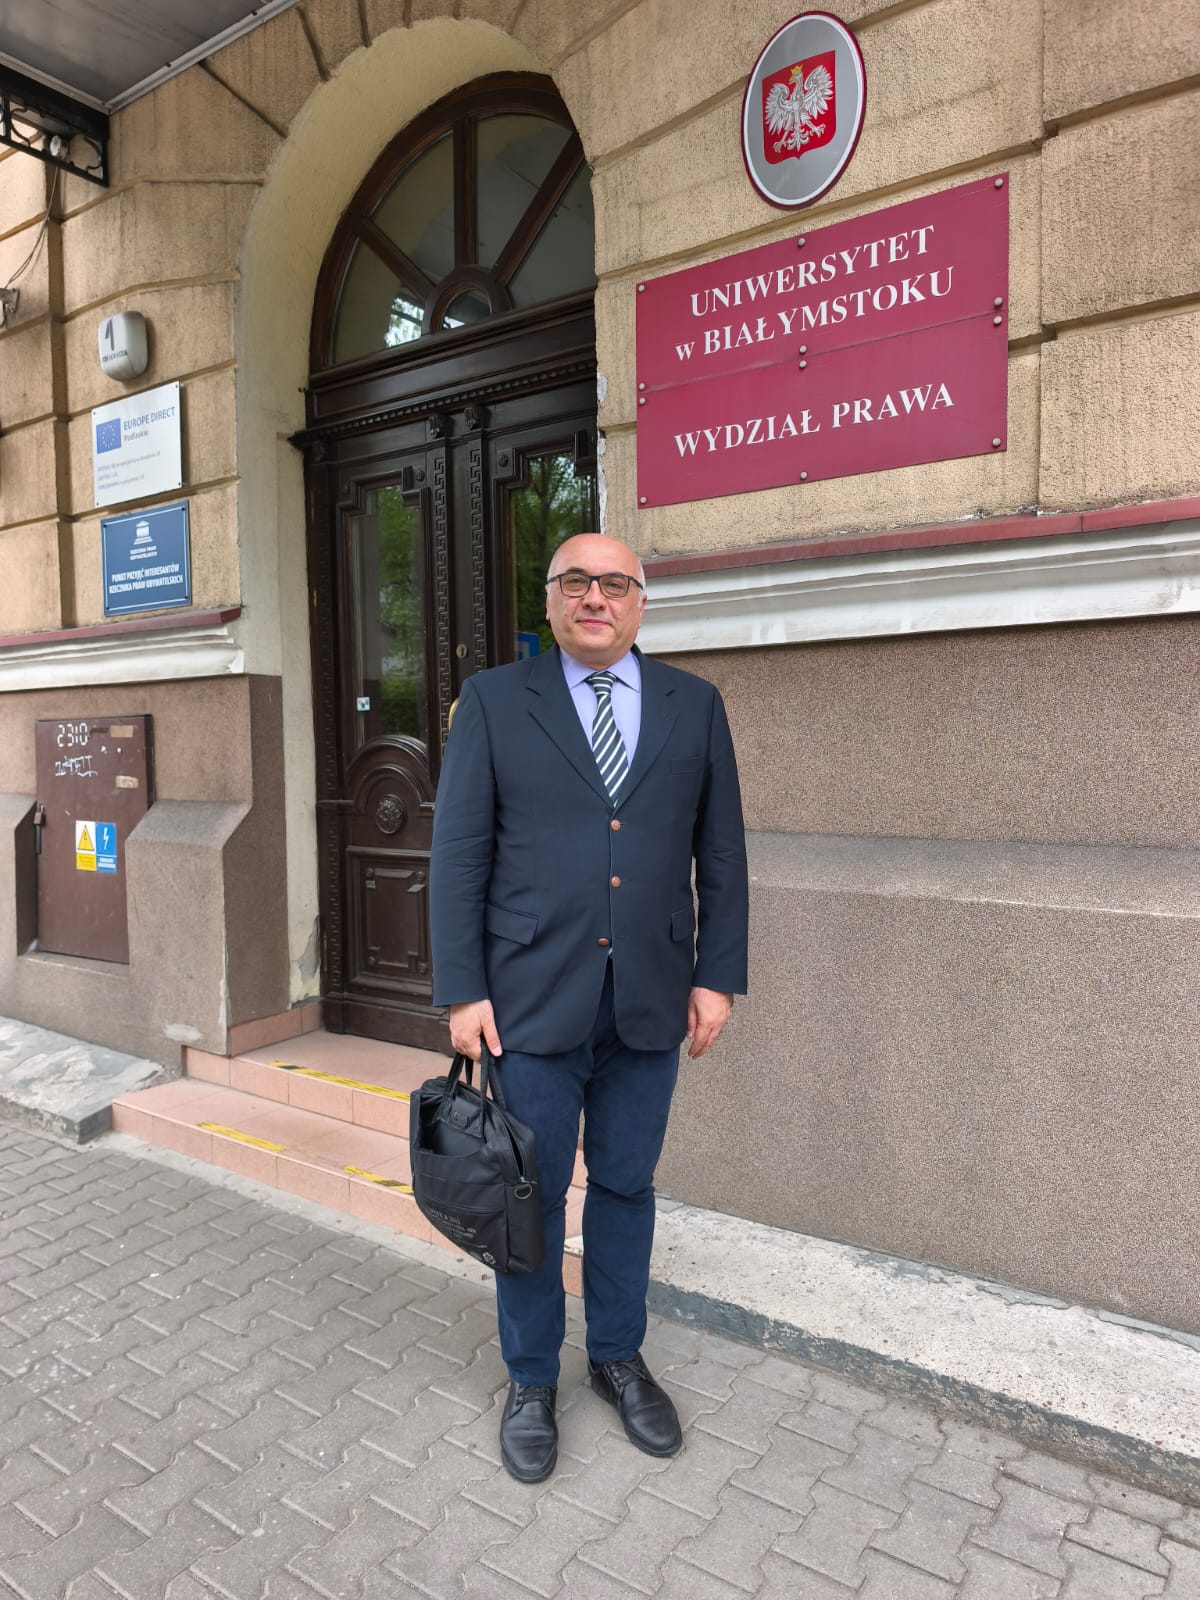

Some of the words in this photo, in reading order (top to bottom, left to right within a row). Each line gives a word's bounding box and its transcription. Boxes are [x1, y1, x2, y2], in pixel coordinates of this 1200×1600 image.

[690, 225, 935, 316] UNIWERSYTET
[105, 319, 115, 351] 1
[703, 267, 955, 355] BIAŁYMSTOKU
[123, 415, 150, 430] EUROPE
[151, 407, 175, 423] DIRECT
[674, 409, 821, 457] WYDZIAŁ
[831, 382, 956, 428] PRAWA
[57, 723, 88, 747] 2310
